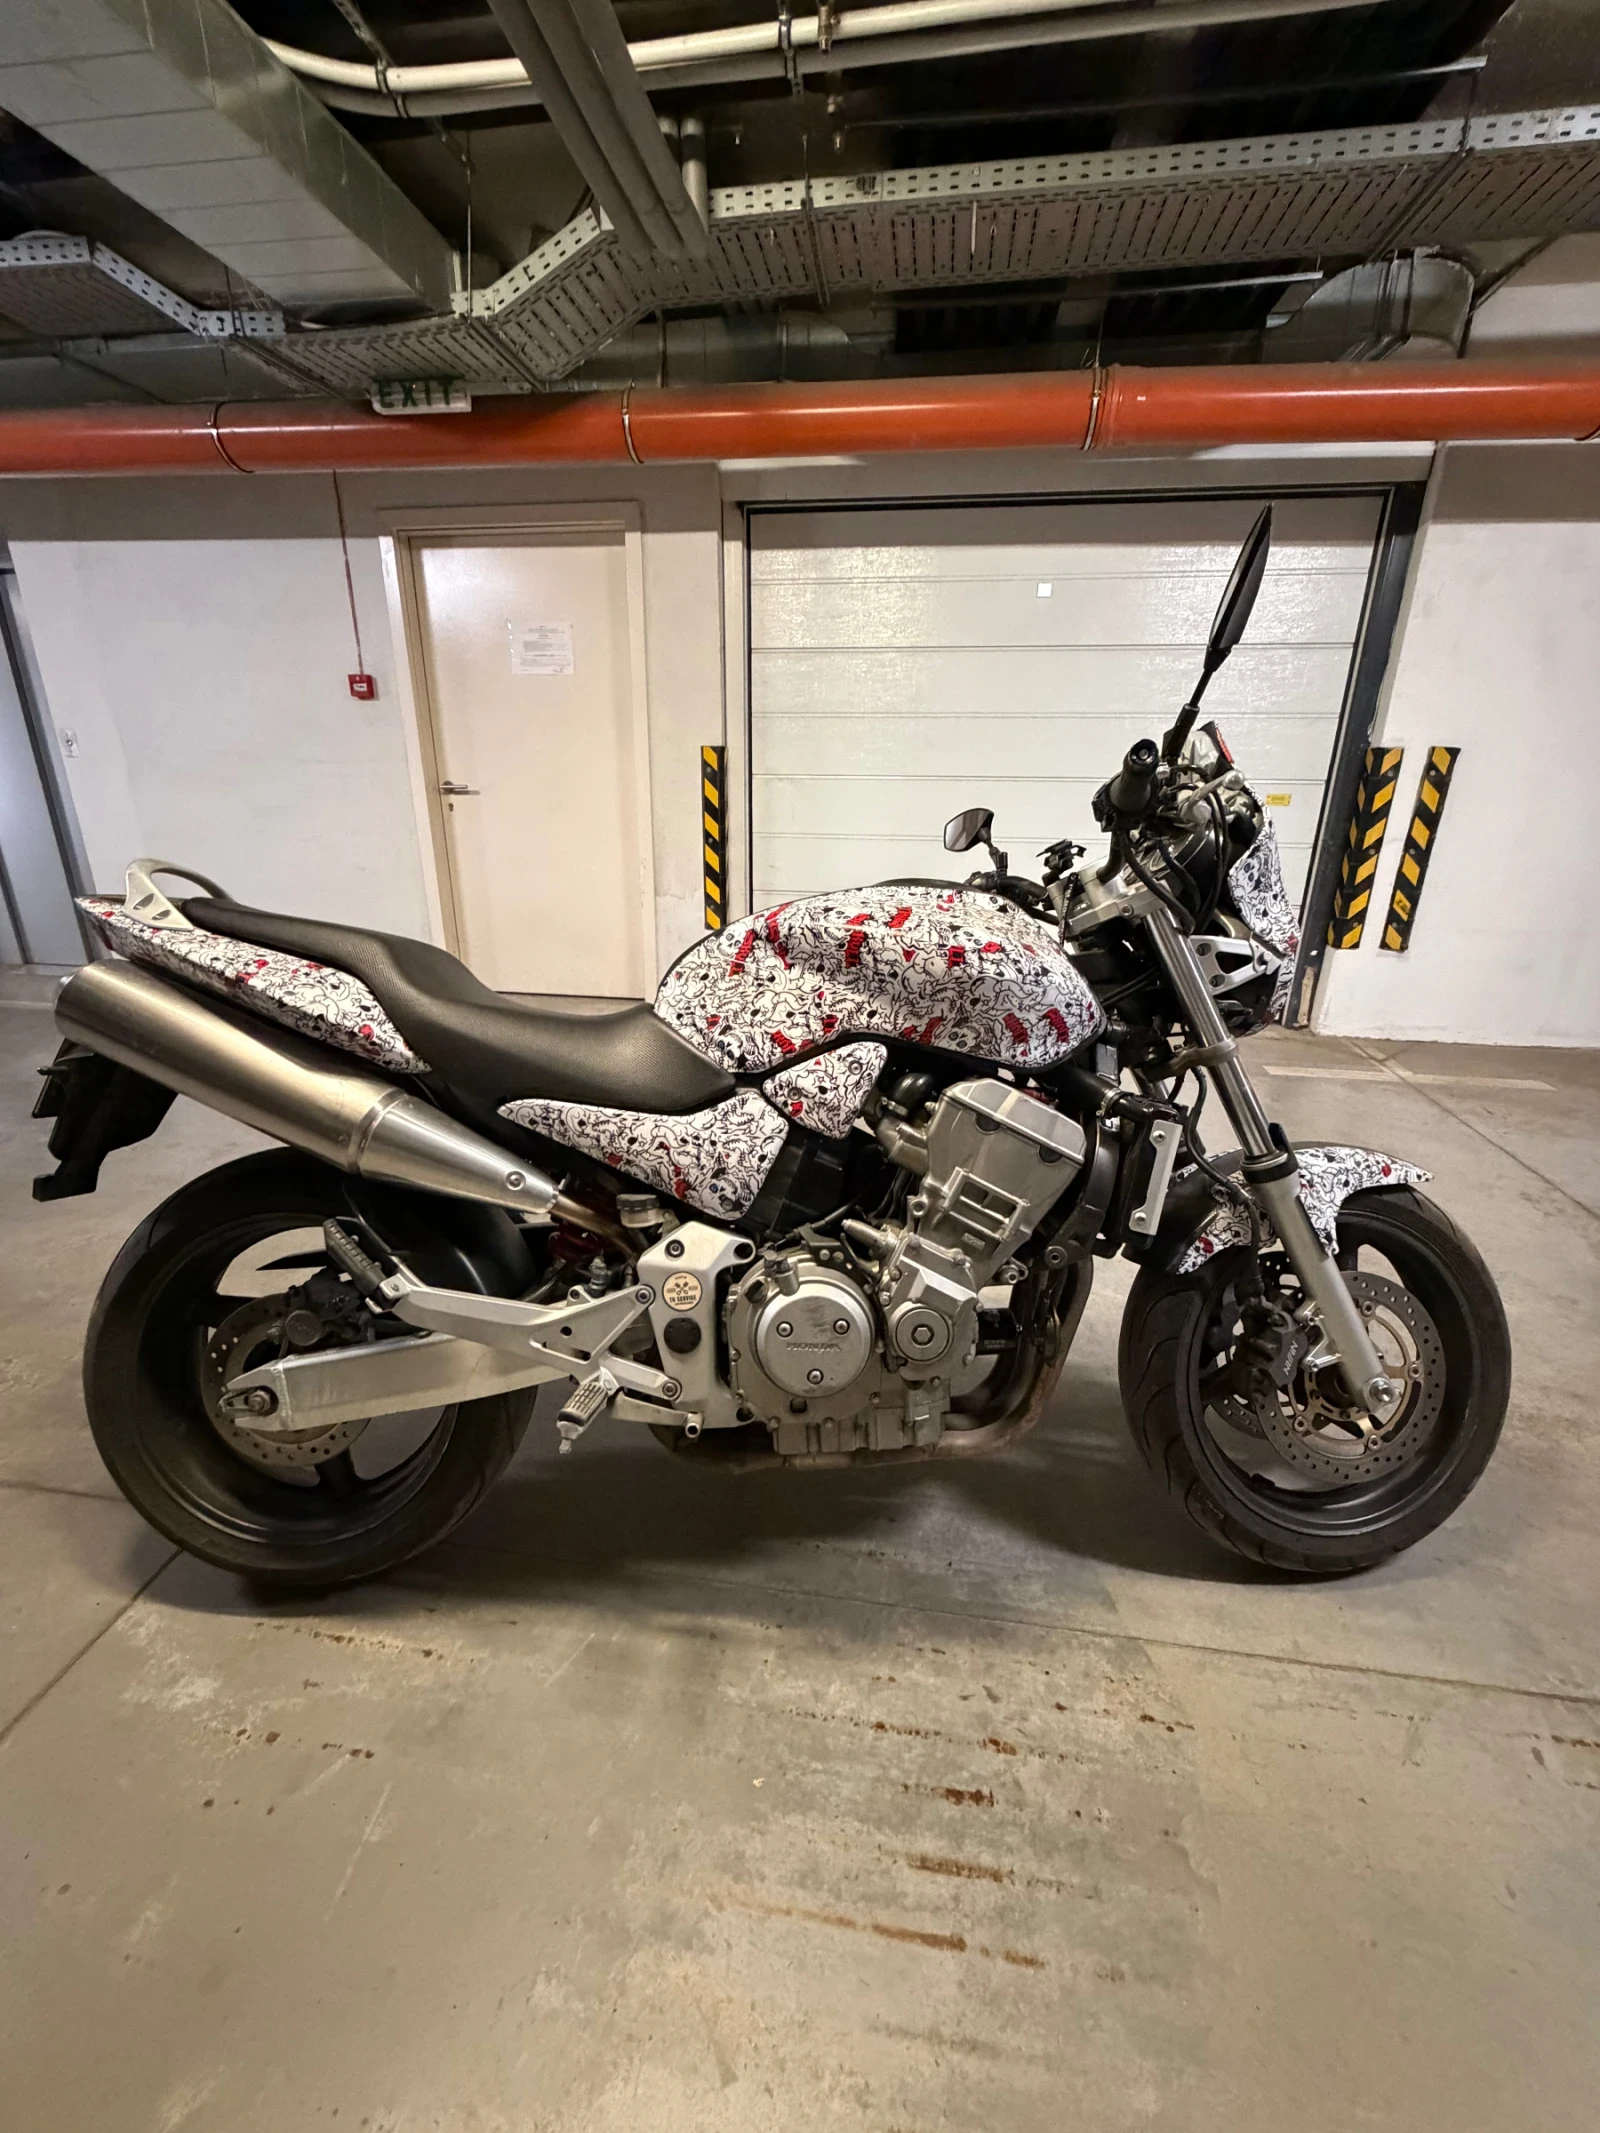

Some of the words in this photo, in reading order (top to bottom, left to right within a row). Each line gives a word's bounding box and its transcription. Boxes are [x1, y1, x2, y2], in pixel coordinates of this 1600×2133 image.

[378, 380, 453, 408] EXIT
[676, 1294, 697, 1302] SERVICE
[785, 1342, 842, 1352] HONDA
[1283, 1340, 1298, 1376] NISSIN
